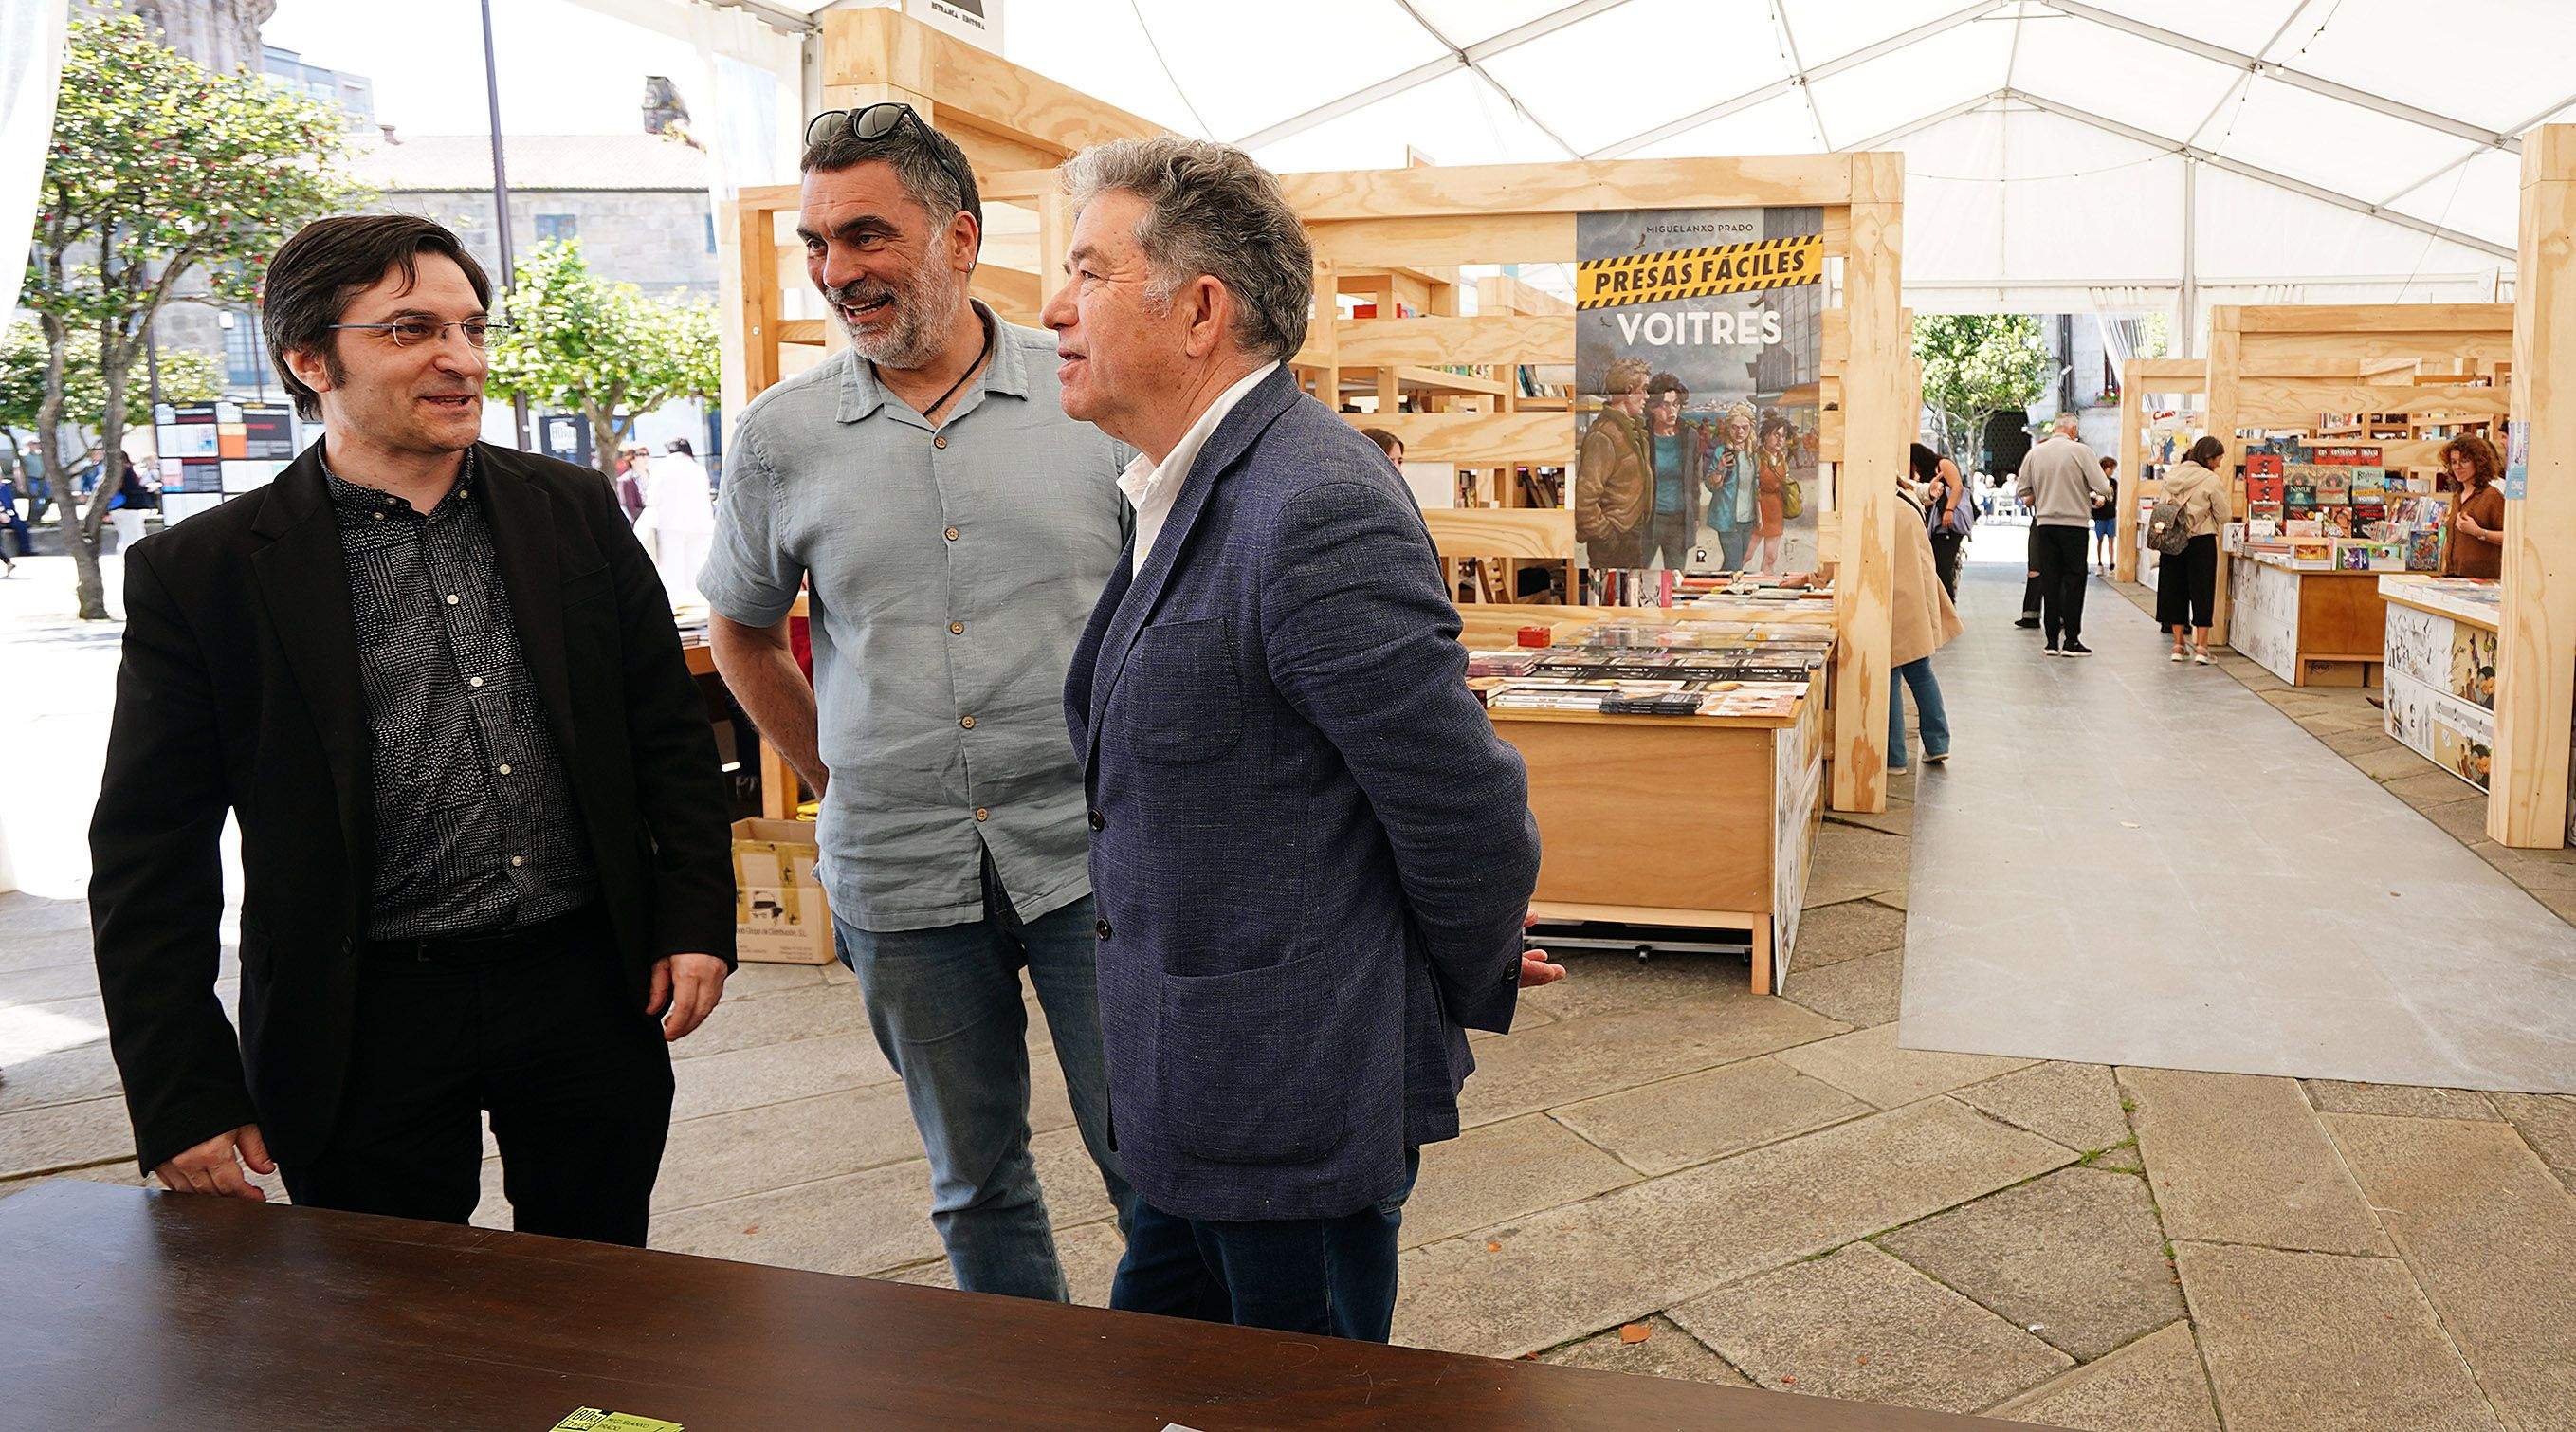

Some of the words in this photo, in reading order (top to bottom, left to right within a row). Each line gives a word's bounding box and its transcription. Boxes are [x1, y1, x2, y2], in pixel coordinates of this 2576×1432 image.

[1646, 224, 1715, 233] MIGUELANXO
[1718, 223, 1754, 232] PRADO
[1595, 265, 1692, 295] PRESAS
[1701, 249, 1805, 283] FÁCILES
[1617, 311, 1782, 346] VOITRES
